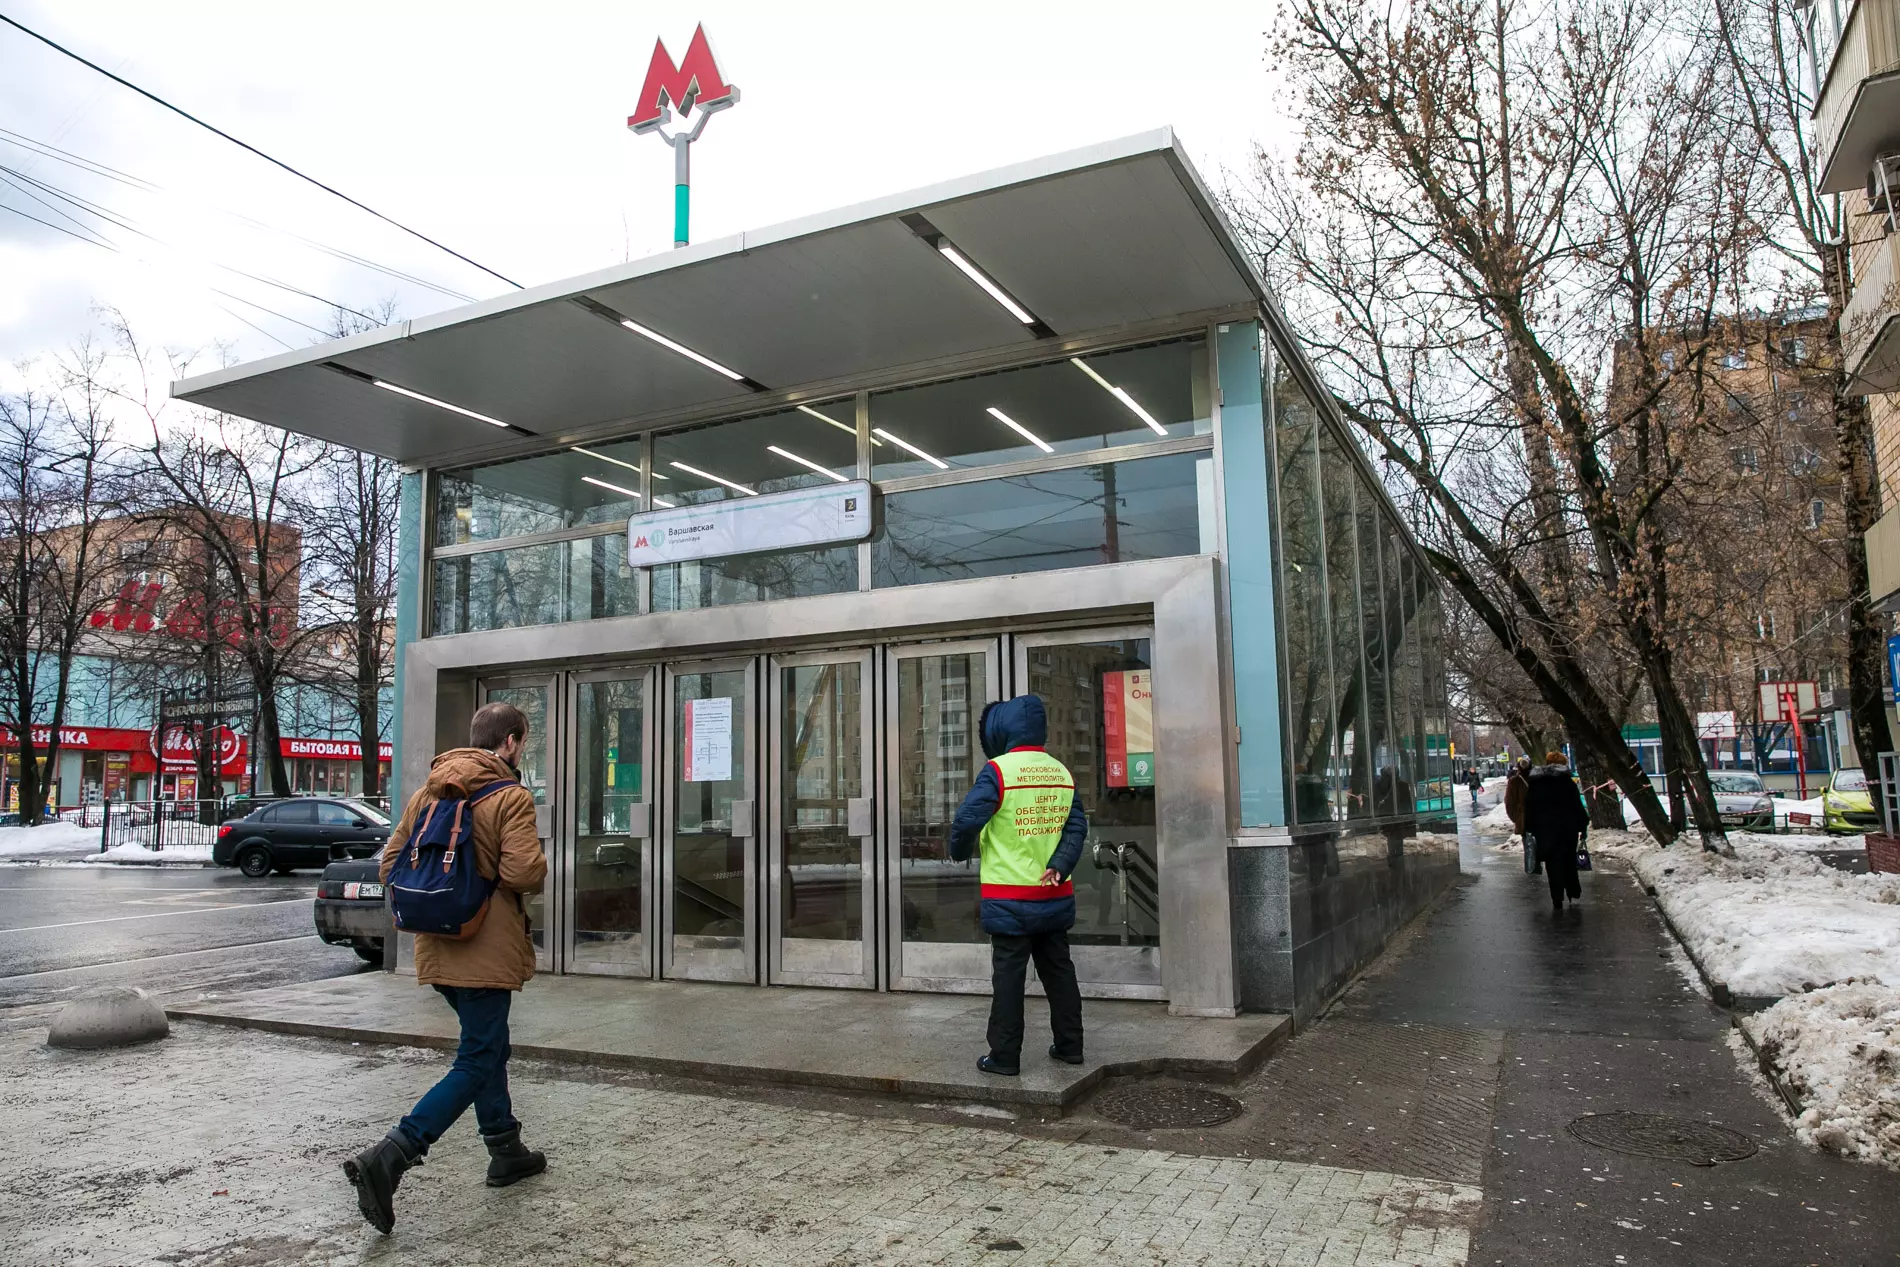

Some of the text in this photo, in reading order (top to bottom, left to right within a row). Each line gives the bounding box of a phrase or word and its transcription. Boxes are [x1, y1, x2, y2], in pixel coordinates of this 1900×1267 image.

[847, 500, 855, 510] 2
[668, 523, 714, 536] Варшавская
[291, 741, 349, 755] БЫТОВАЯ
[1034, 795, 1058, 804] ЦЕНТР
